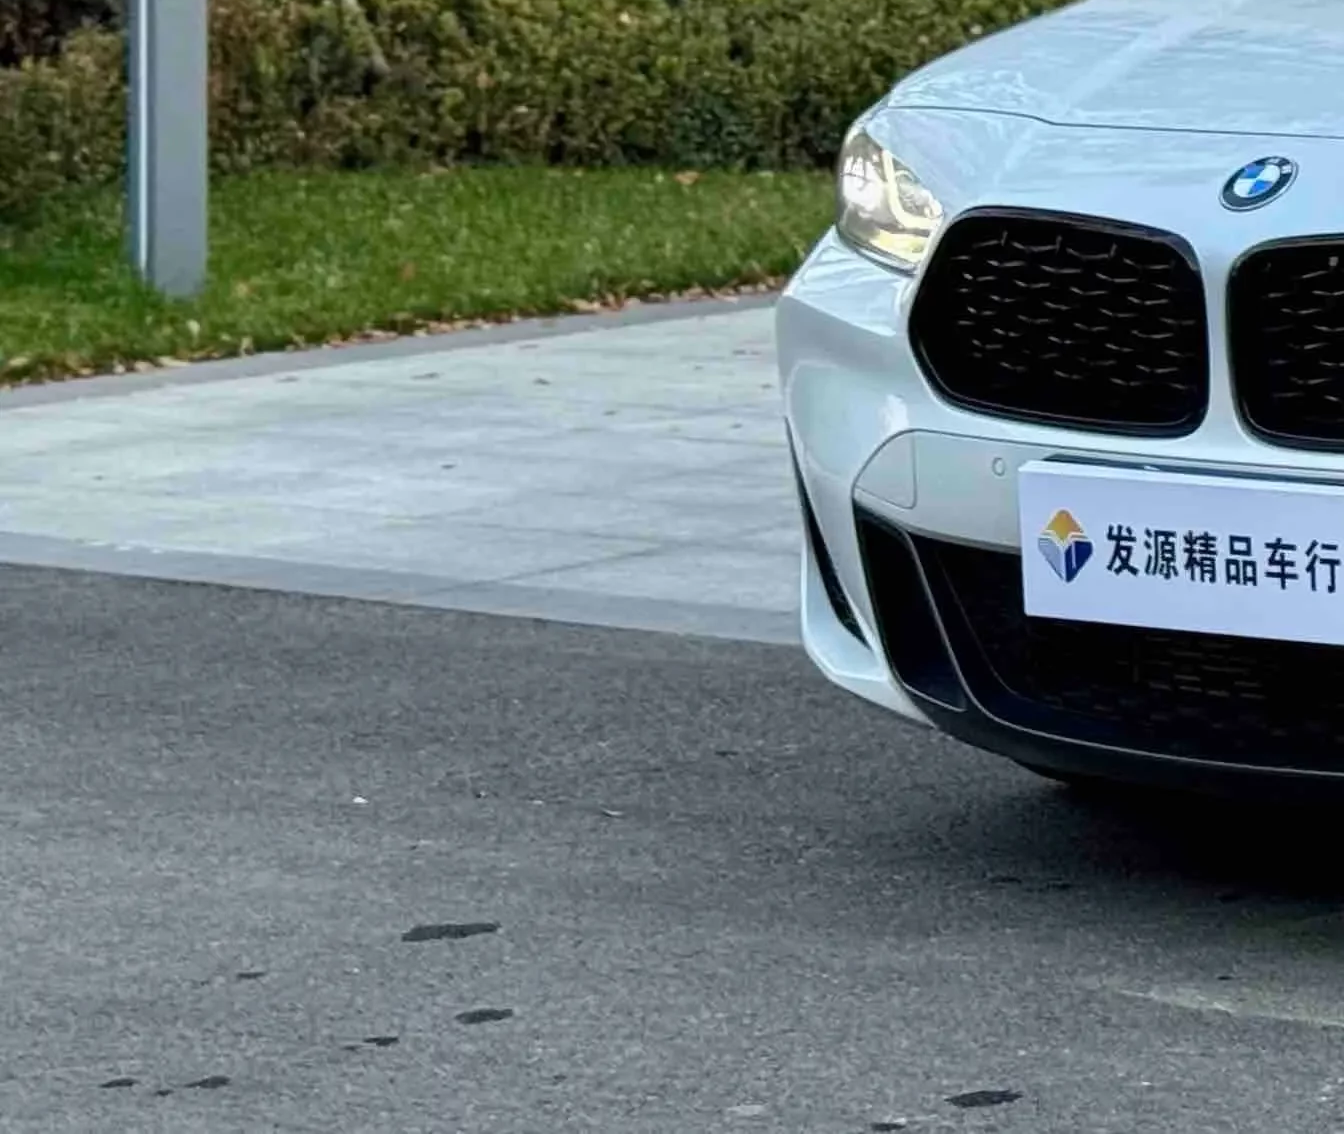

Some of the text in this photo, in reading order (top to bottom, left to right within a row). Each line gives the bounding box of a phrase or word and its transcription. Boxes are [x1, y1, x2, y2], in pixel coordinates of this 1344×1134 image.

[1105, 523, 1342, 594] 发源精品车行
